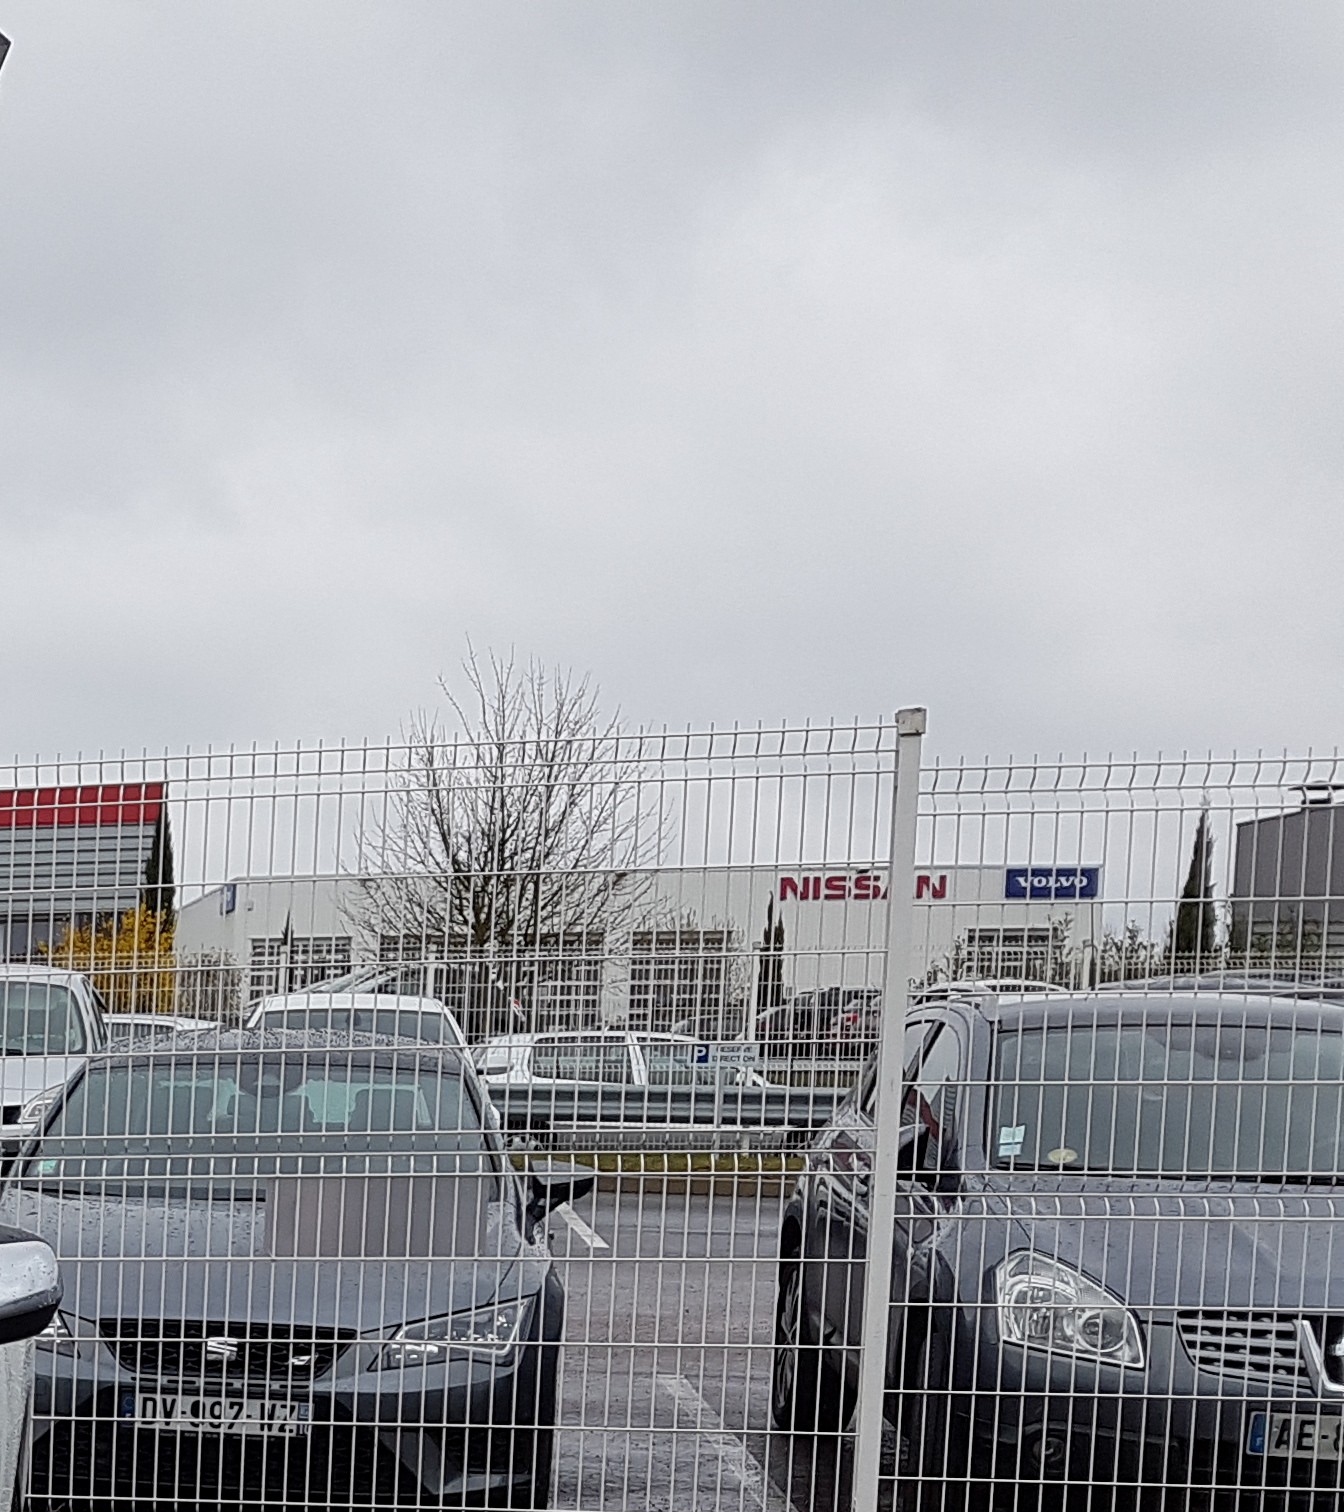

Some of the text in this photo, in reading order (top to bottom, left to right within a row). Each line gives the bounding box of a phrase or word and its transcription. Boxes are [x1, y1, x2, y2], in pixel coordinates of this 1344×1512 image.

[780, 875, 947, 900] NISSN
[1015, 876, 1089, 888] VOLVO
[712, 1055, 756, 1063] DRECTON
